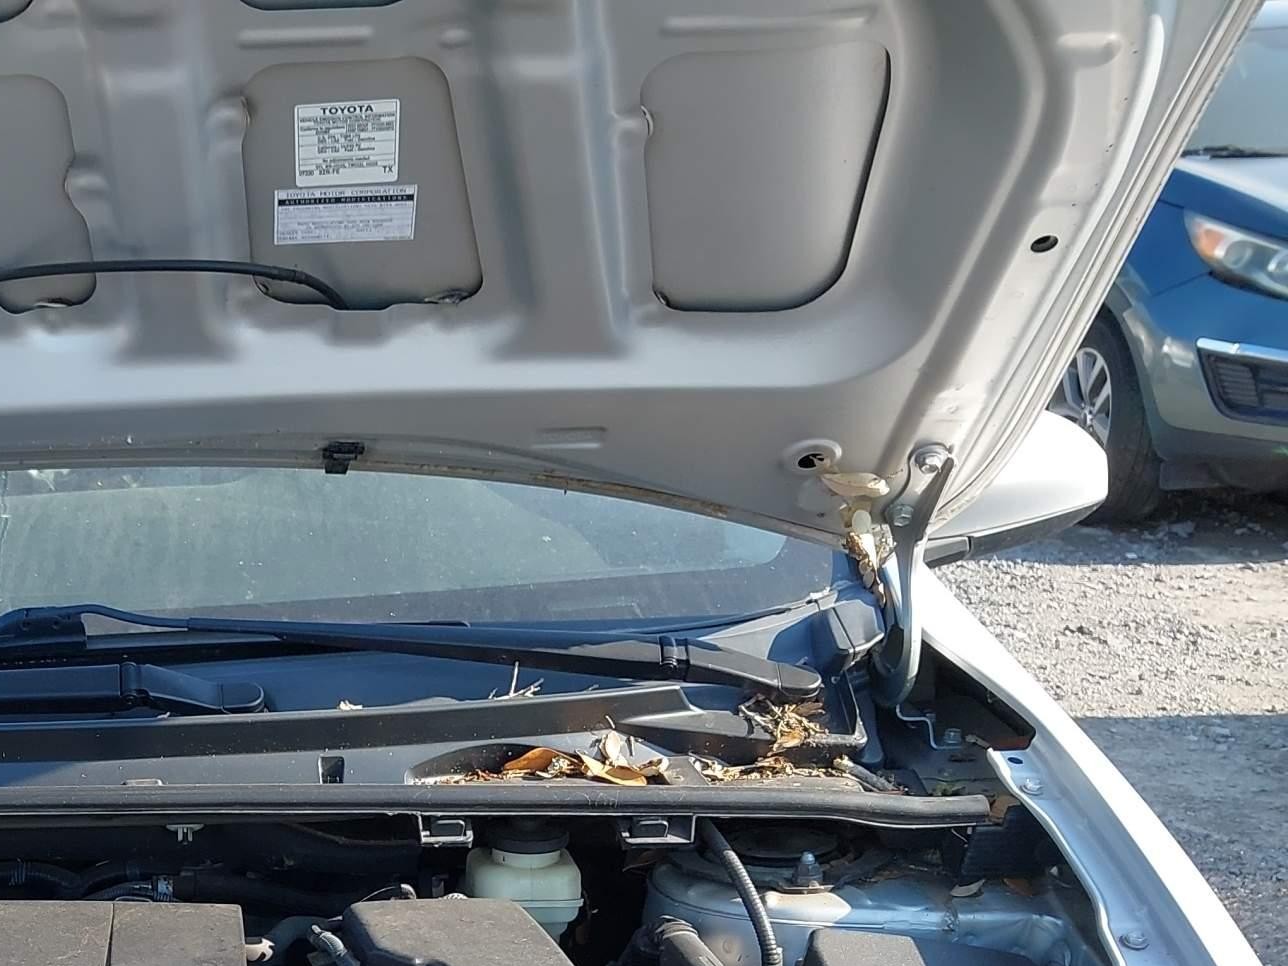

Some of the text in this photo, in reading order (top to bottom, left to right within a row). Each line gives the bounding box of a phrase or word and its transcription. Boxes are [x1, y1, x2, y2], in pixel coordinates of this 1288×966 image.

[320, 105, 374, 115] TOYOTA
[382, 165, 393, 174] TX
[350, 188, 407, 196] CORPORATION
